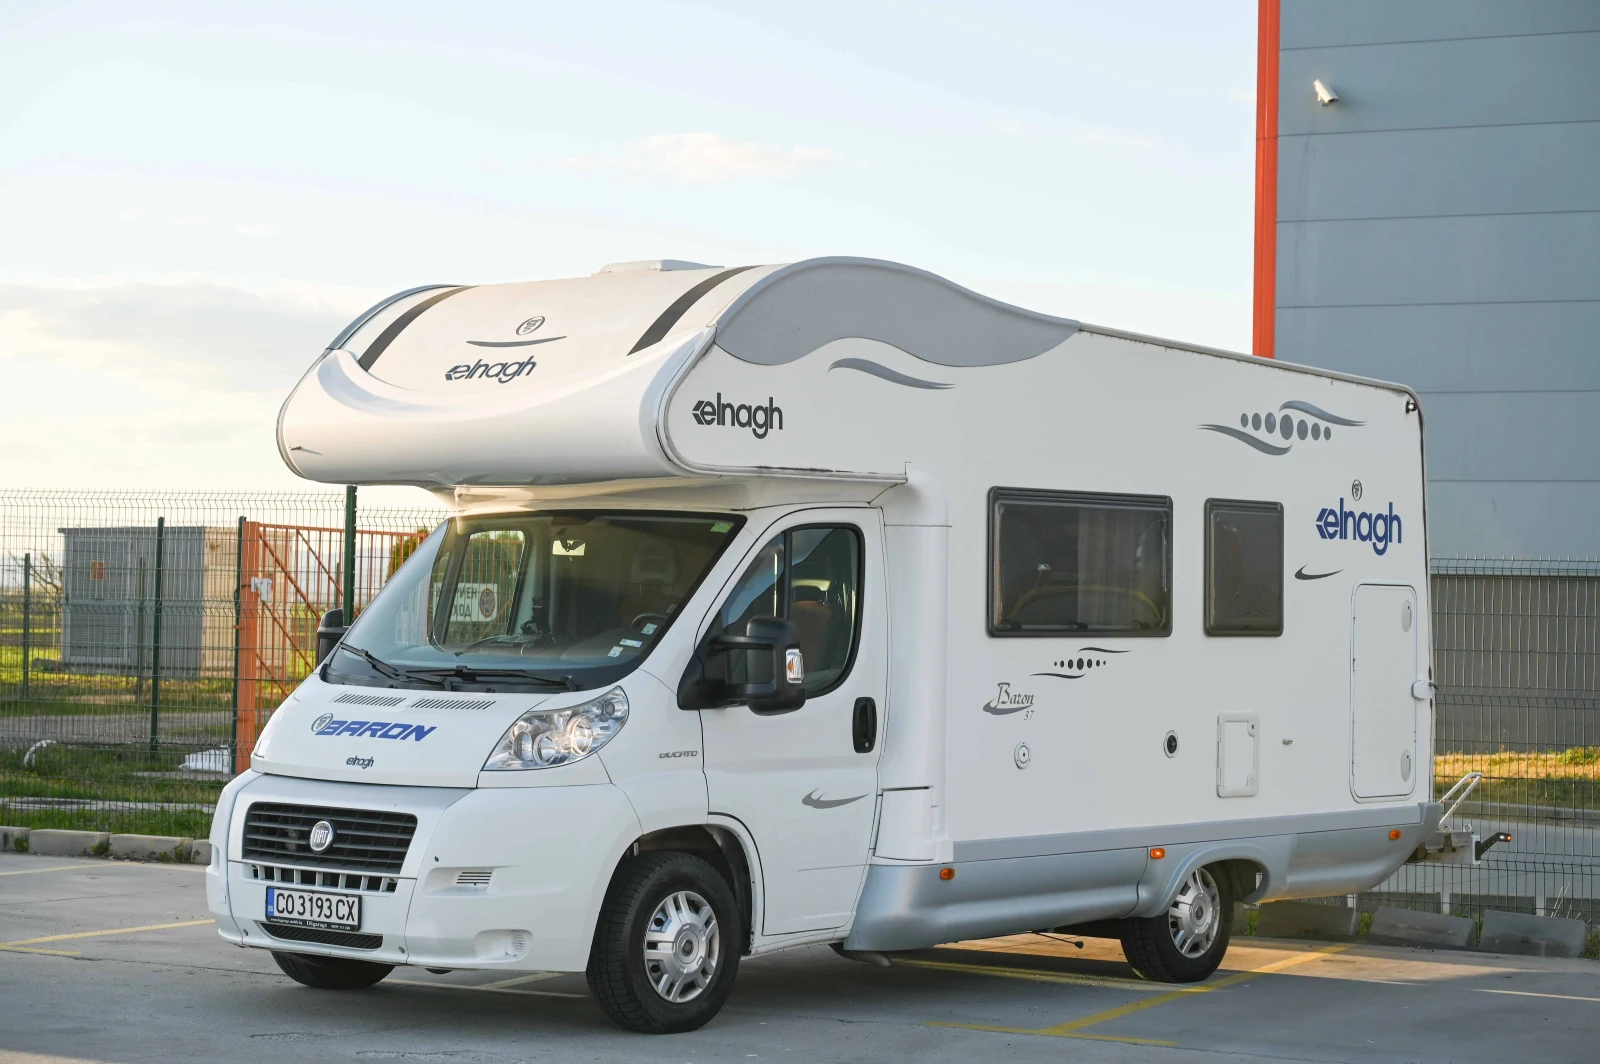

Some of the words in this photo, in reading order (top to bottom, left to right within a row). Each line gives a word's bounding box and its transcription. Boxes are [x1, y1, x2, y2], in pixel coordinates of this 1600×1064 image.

[452, 355, 537, 384] elnagh
[699, 392, 783, 440] elnagh
[1323, 497, 1402, 556] elnagh
[993, 681, 1035, 708] Baron
[1023, 710, 1035, 721] 37
[315, 719, 438, 742] BARON
[346, 755, 375, 769] elnagh
[658, 750, 698, 759] DUCATO
[314, 829, 328, 844] FIAT
[276, 892, 295, 915] CO
[297, 894, 333, 919] 3193
[335, 898, 356, 922] CX
